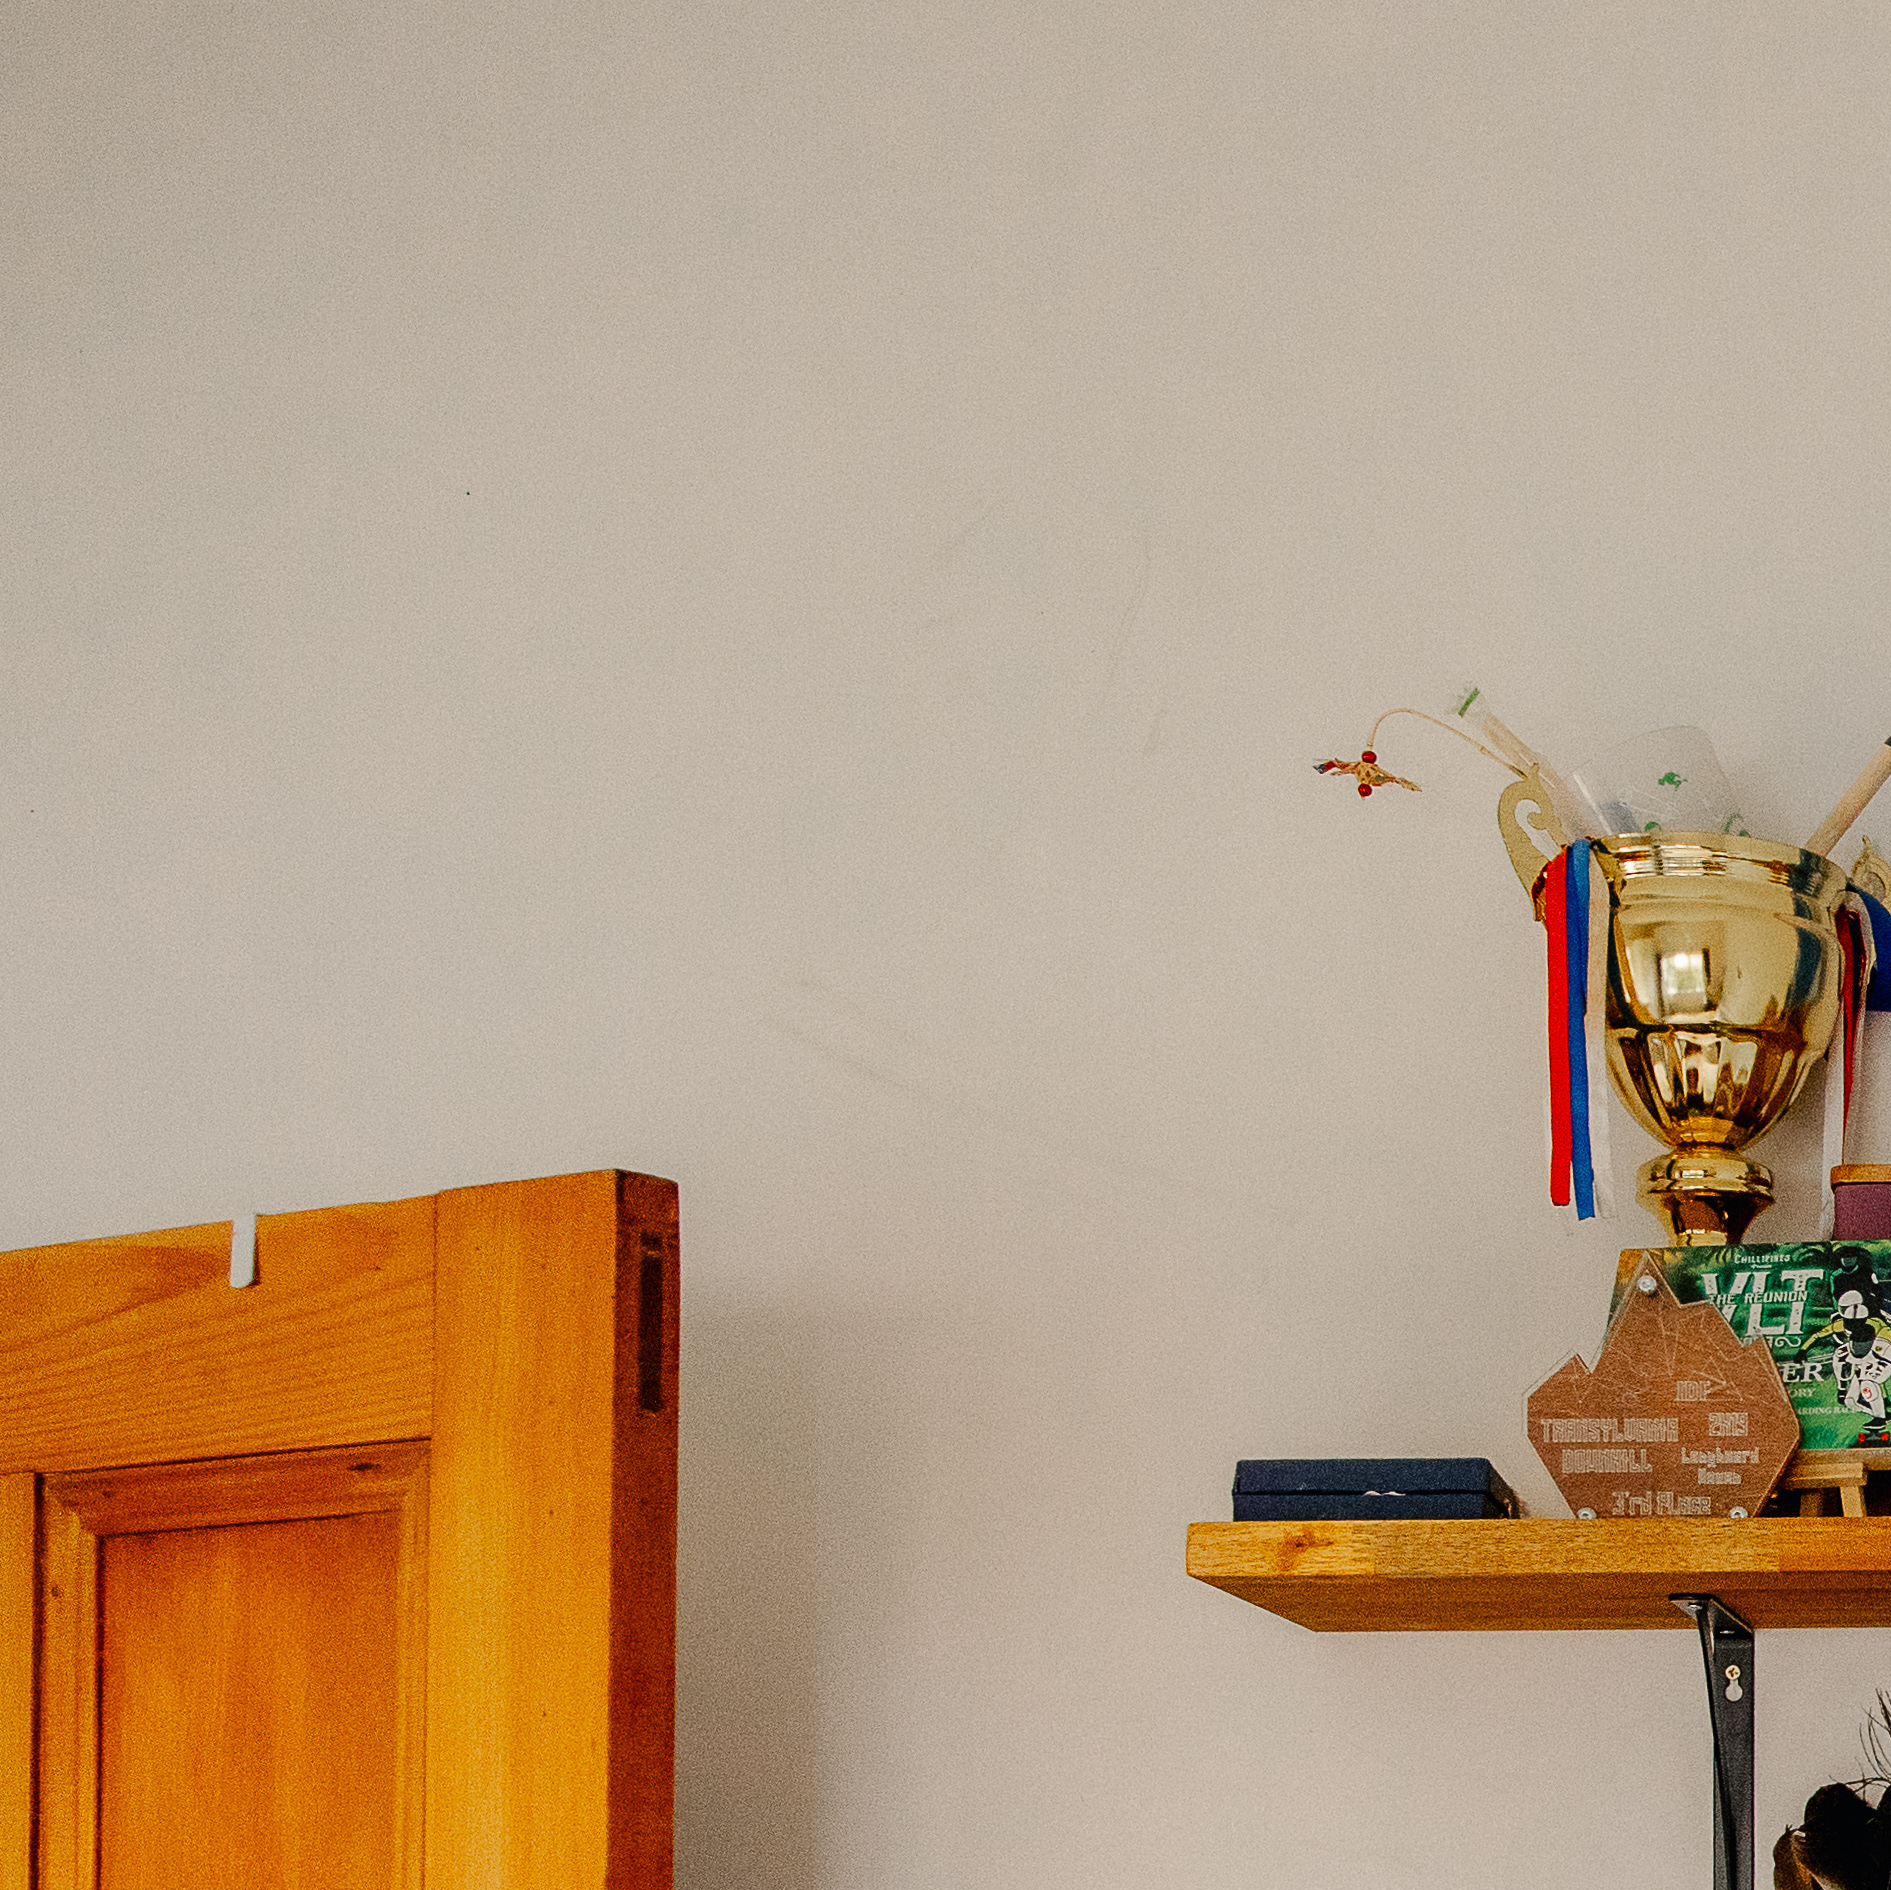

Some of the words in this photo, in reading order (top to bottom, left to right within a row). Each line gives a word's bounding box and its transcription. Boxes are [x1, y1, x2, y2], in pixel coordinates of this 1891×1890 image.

[1744, 1291, 1808, 1304] REUNION
[1541, 1417, 1679, 1443] TRANSYLVANIA
[1561, 1449, 1653, 1475] DOWNHILL
